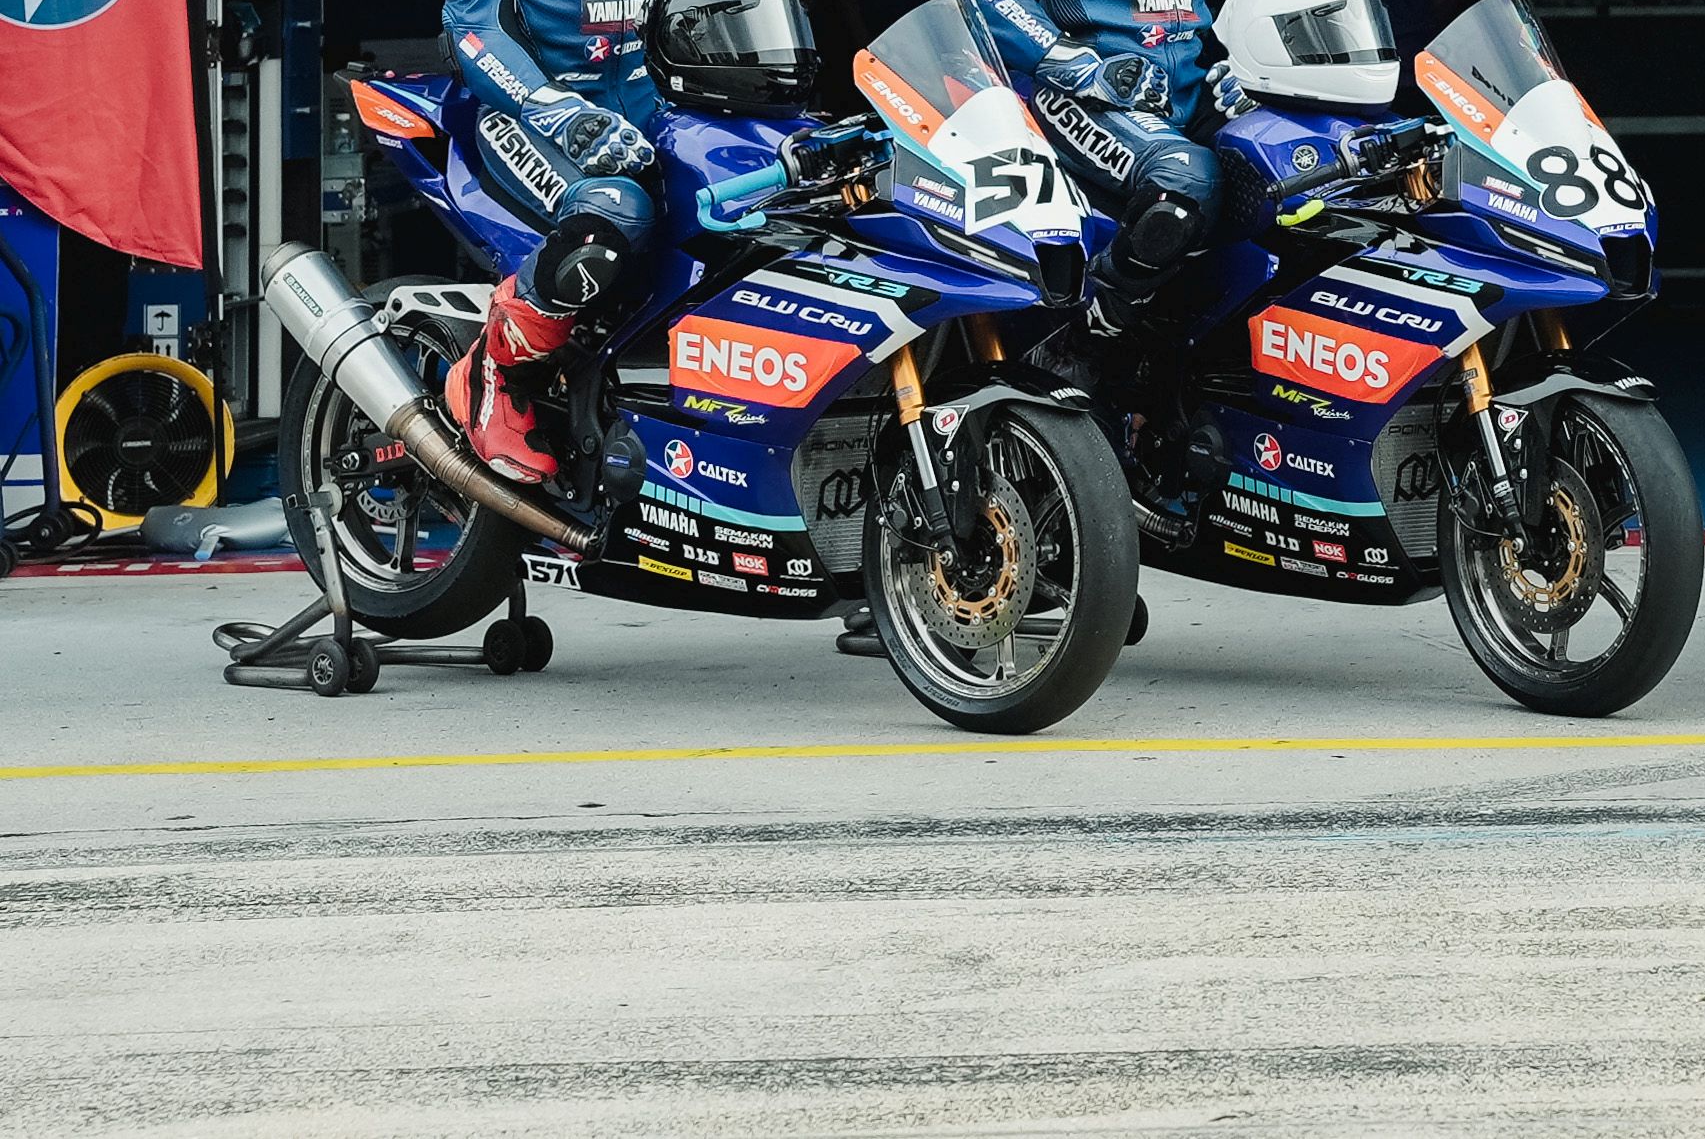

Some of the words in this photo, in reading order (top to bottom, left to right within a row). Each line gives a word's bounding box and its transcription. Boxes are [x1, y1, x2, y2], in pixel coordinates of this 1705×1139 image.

[872, 78, 922, 126] ENEOS
[1434, 80, 1486, 124] ENEOS
[1526, 145, 1646, 218] 88
[914, 191, 964, 222] YAMAHA
[1487, 193, 1538, 224] YAMAHA
[732, 290, 799, 316] BLU
[802, 308, 873, 336] CRU
[1311, 291, 1375, 317] BLU
[1376, 307, 1443, 332] CRU
[676, 332, 809, 392] ENEOS
[1261, 320, 1391, 389] ENEOS
[698, 460, 748, 488] CALTEX
[1286, 453, 1335, 478] CALTEX
[639, 502, 700, 538] YAMAHA
[1222, 490, 1280, 525] YAMAHA
[1294, 513, 1350, 531] SEMAKIN
[714, 525, 773, 542] SEMAKIN
[1314, 543, 1343, 557] NGK
[735, 557, 764, 570] NGK
